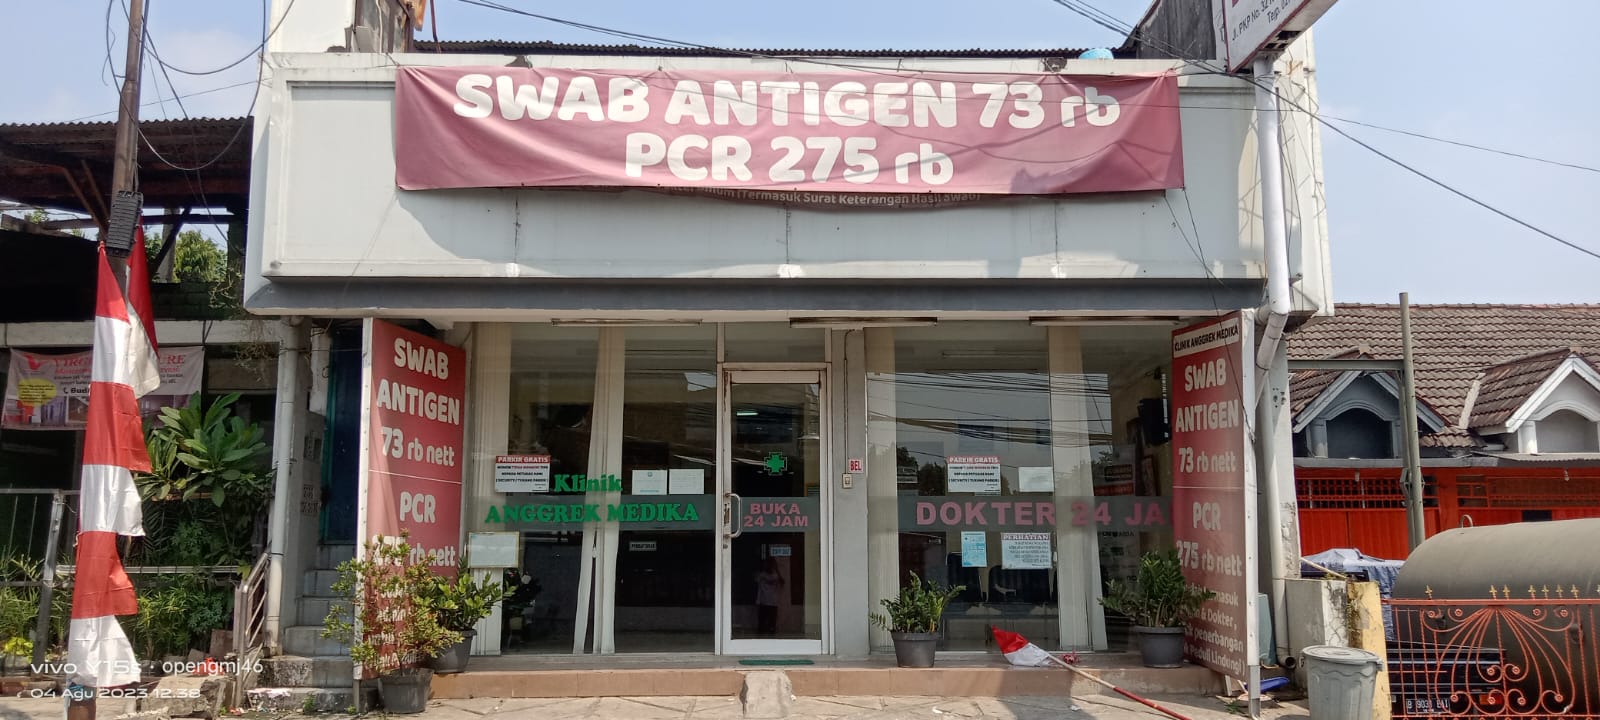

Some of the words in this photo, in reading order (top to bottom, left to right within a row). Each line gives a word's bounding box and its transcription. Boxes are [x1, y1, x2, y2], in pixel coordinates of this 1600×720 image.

[1238, 15, 1251, 34] PKP
[453, 73, 650, 123] SWAB
[664, 79, 957, 128] ANTIGEN
[971, 81, 1045, 129] 73
[1060, 86, 1121, 128] rb
[625, 132, 752, 181] PCR
[768, 135, 880, 185] 275
[895, 143, 954, 185] rb
[803, 192, 836, 204] Surat
[838, 193, 909, 206] Keterangan
[911, 193, 941, 204] Hasil
[1174, 339, 1190, 352] KLINIK
[1191, 332, 1216, 349] ANGGREK
[1216, 323, 1239, 341] MEDIKA
[393, 337, 449, 380] SWAB
[1184, 358, 1227, 392] SWAB
[376, 378, 461, 426] ANTIGEN
[1175, 399, 1239, 433] ANTIGEN
[380, 426, 404, 459] 73
[407, 437, 424, 462] rb
[426, 444, 456, 467] nett
[1178, 446, 1194, 473] 73
[1197, 450, 1209, 473] rb
[1211, 452, 1237, 473] nett
[850, 460, 862, 471] BEL
[554, 473, 623, 492] Klinik
[399, 491, 436, 523] PCR
[484, 504, 601, 524] ANGGREK
[607, 503, 699, 522] MEDIKA
[743, 515, 765, 527] 24
[770, 515, 809, 527] JAM
[750, 502, 801, 515] BUKA
[916, 501, 1056, 525] DOKTER
[1071, 501, 1112, 526] 24
[1192, 501, 1222, 531] PCR
[1176, 540, 1199, 569] 275
[1202, 549, 1215, 571] rb
[1217, 554, 1242, 577] nett
[1208, 608, 1233, 627] Dokter
[1193, 627, 1244, 653] penerbangan
